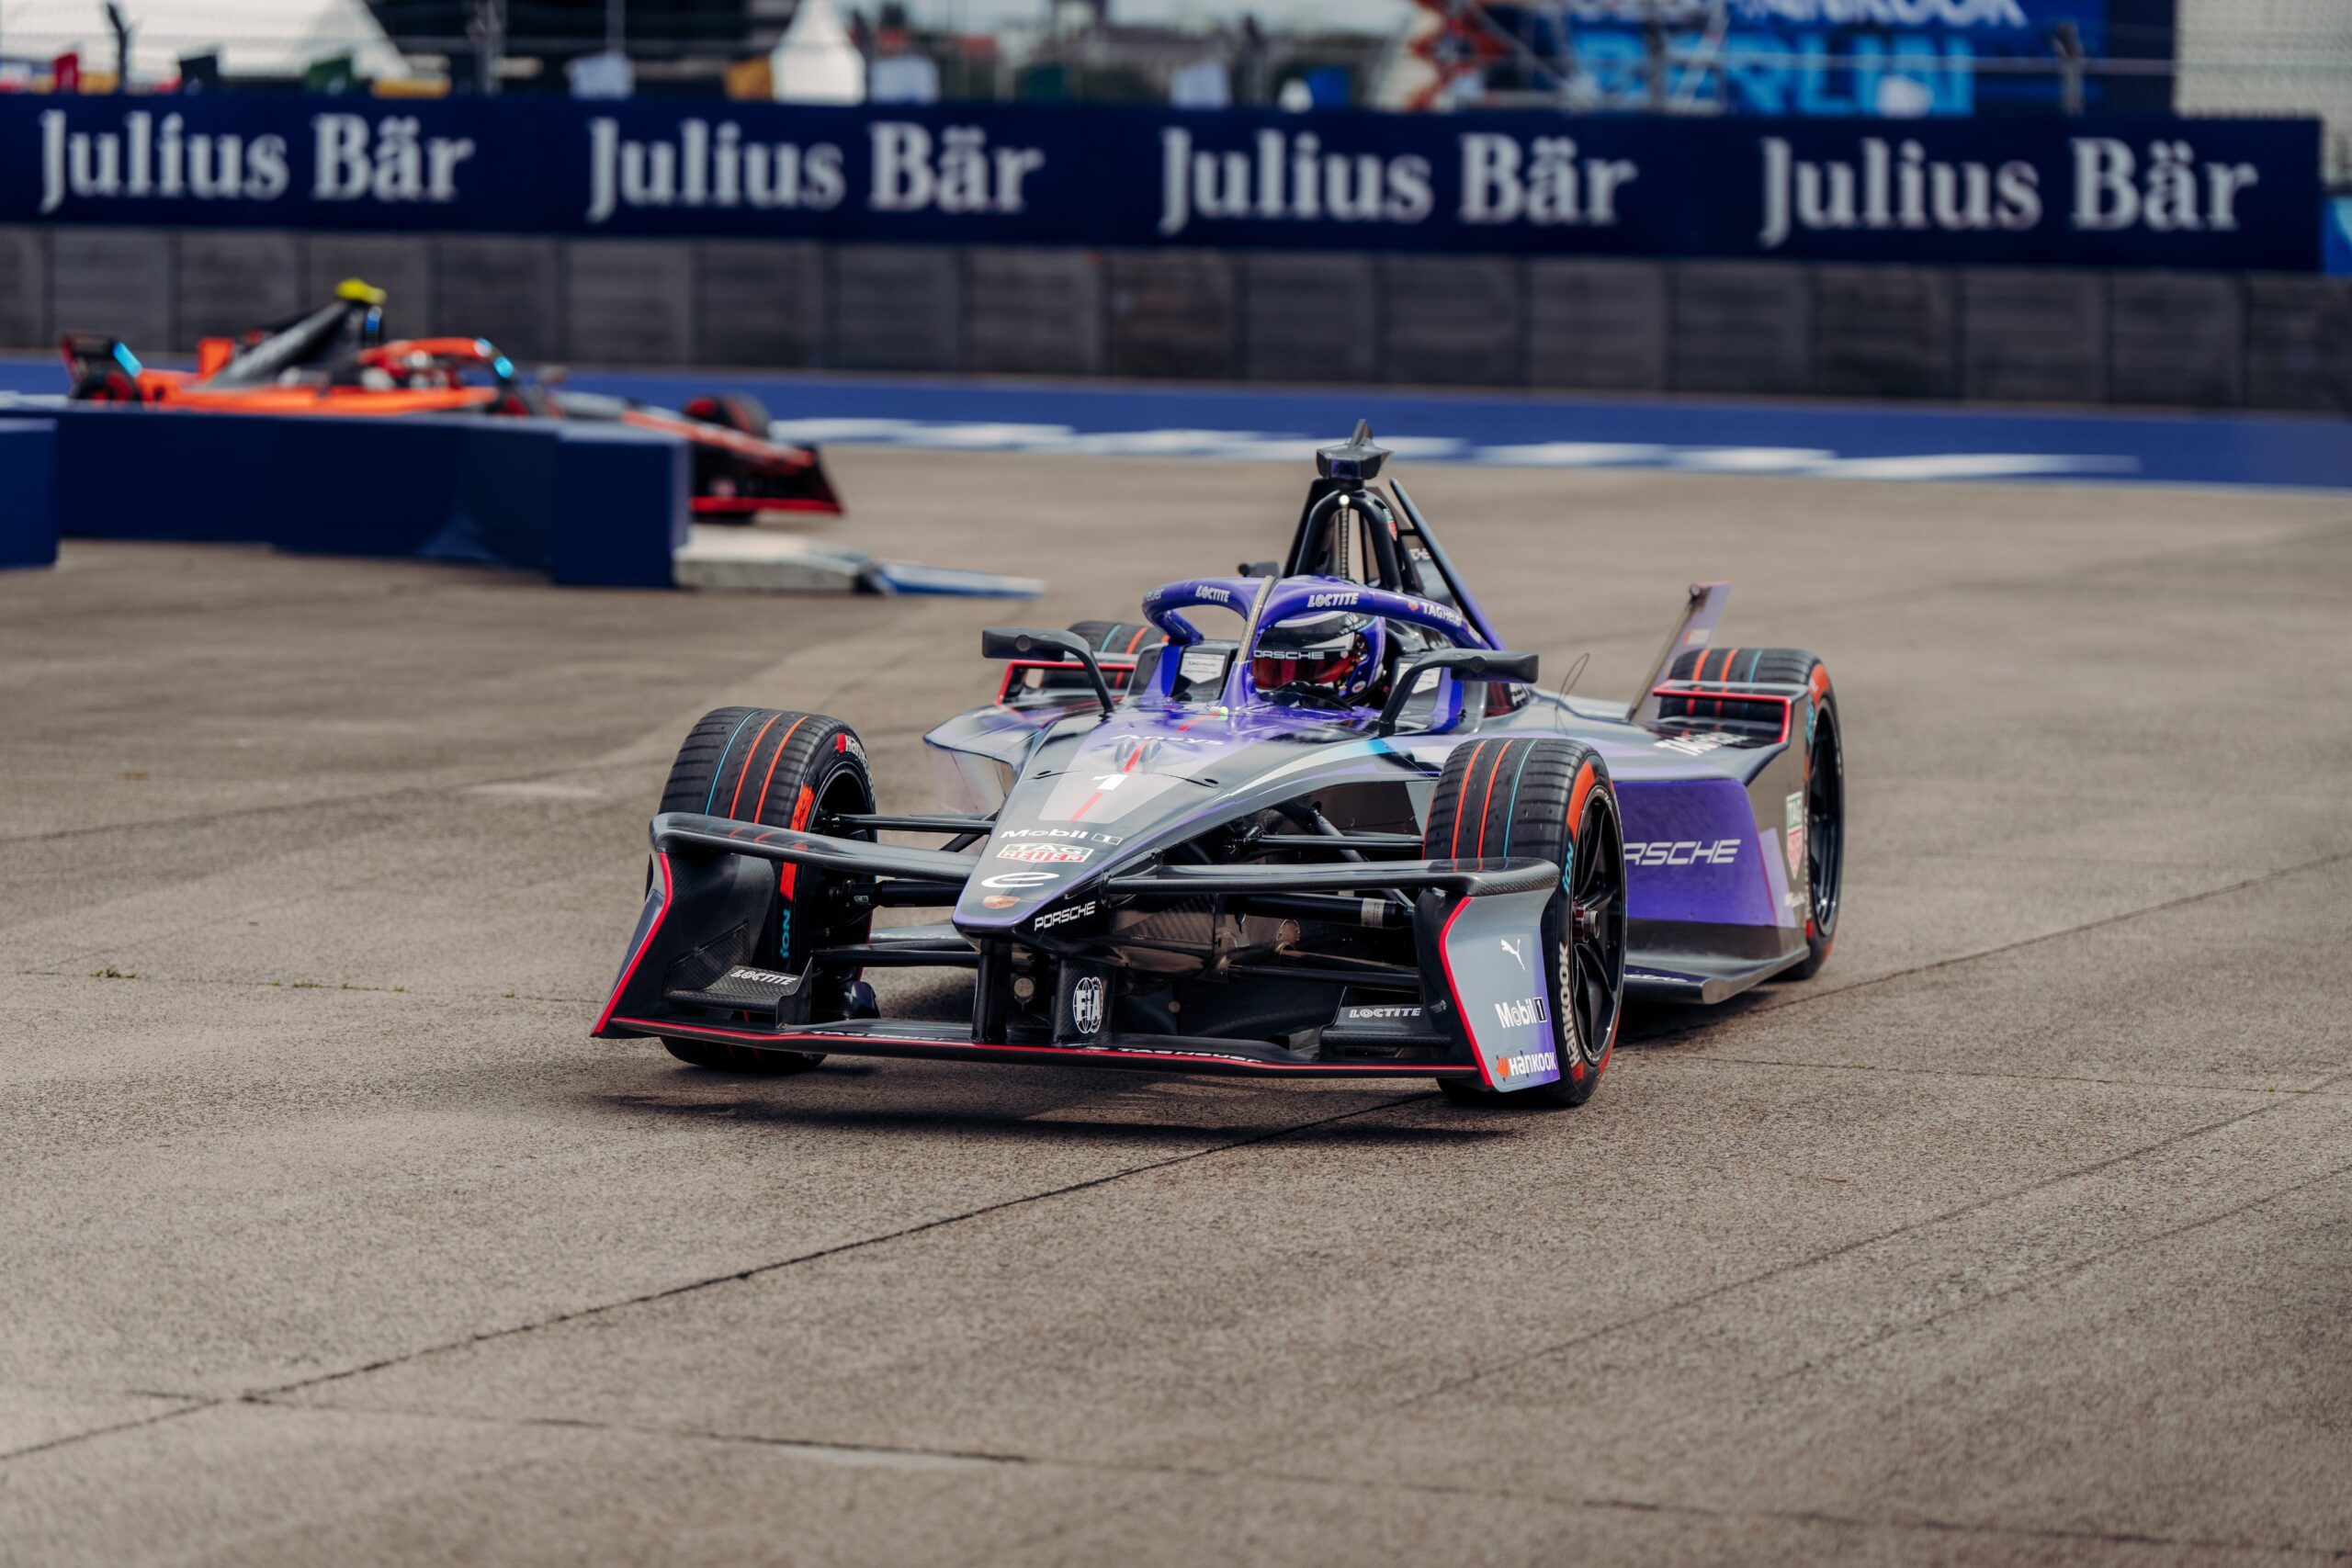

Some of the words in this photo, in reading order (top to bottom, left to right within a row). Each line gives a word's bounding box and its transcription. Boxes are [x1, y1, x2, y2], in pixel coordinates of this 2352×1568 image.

[40, 109, 289, 211] Julius
[312, 114, 474, 200] Bär
[588, 118, 846, 220] Julius
[870, 121, 1045, 212] Bär
[1161, 128, 1433, 232] Julius
[1461, 133, 1636, 223] Bär
[1760, 138, 2041, 246] Julius
[2072, 139, 2259, 230] Bär
[1195, 585, 1231, 603] LOCTITE
[1306, 592, 1359, 608] LOCTITE
[1253, 649, 1325, 660] ORSCHE
[1093, 773, 1128, 791] 1
[1000, 829, 1089, 839] Mobil
[1001, 851, 1082, 862] HEUER
[1012, 844, 1081, 854] TAG
[1623, 839, 1741, 865] RSCHE
[1035, 900, 1096, 932] PORSCHE
[730, 969, 798, 986] LOCTITE
[1076, 989, 1101, 1021] FIA
[1349, 1008, 1422, 1019] LOCTITE
[1494, 998, 1537, 1029] Mobil
